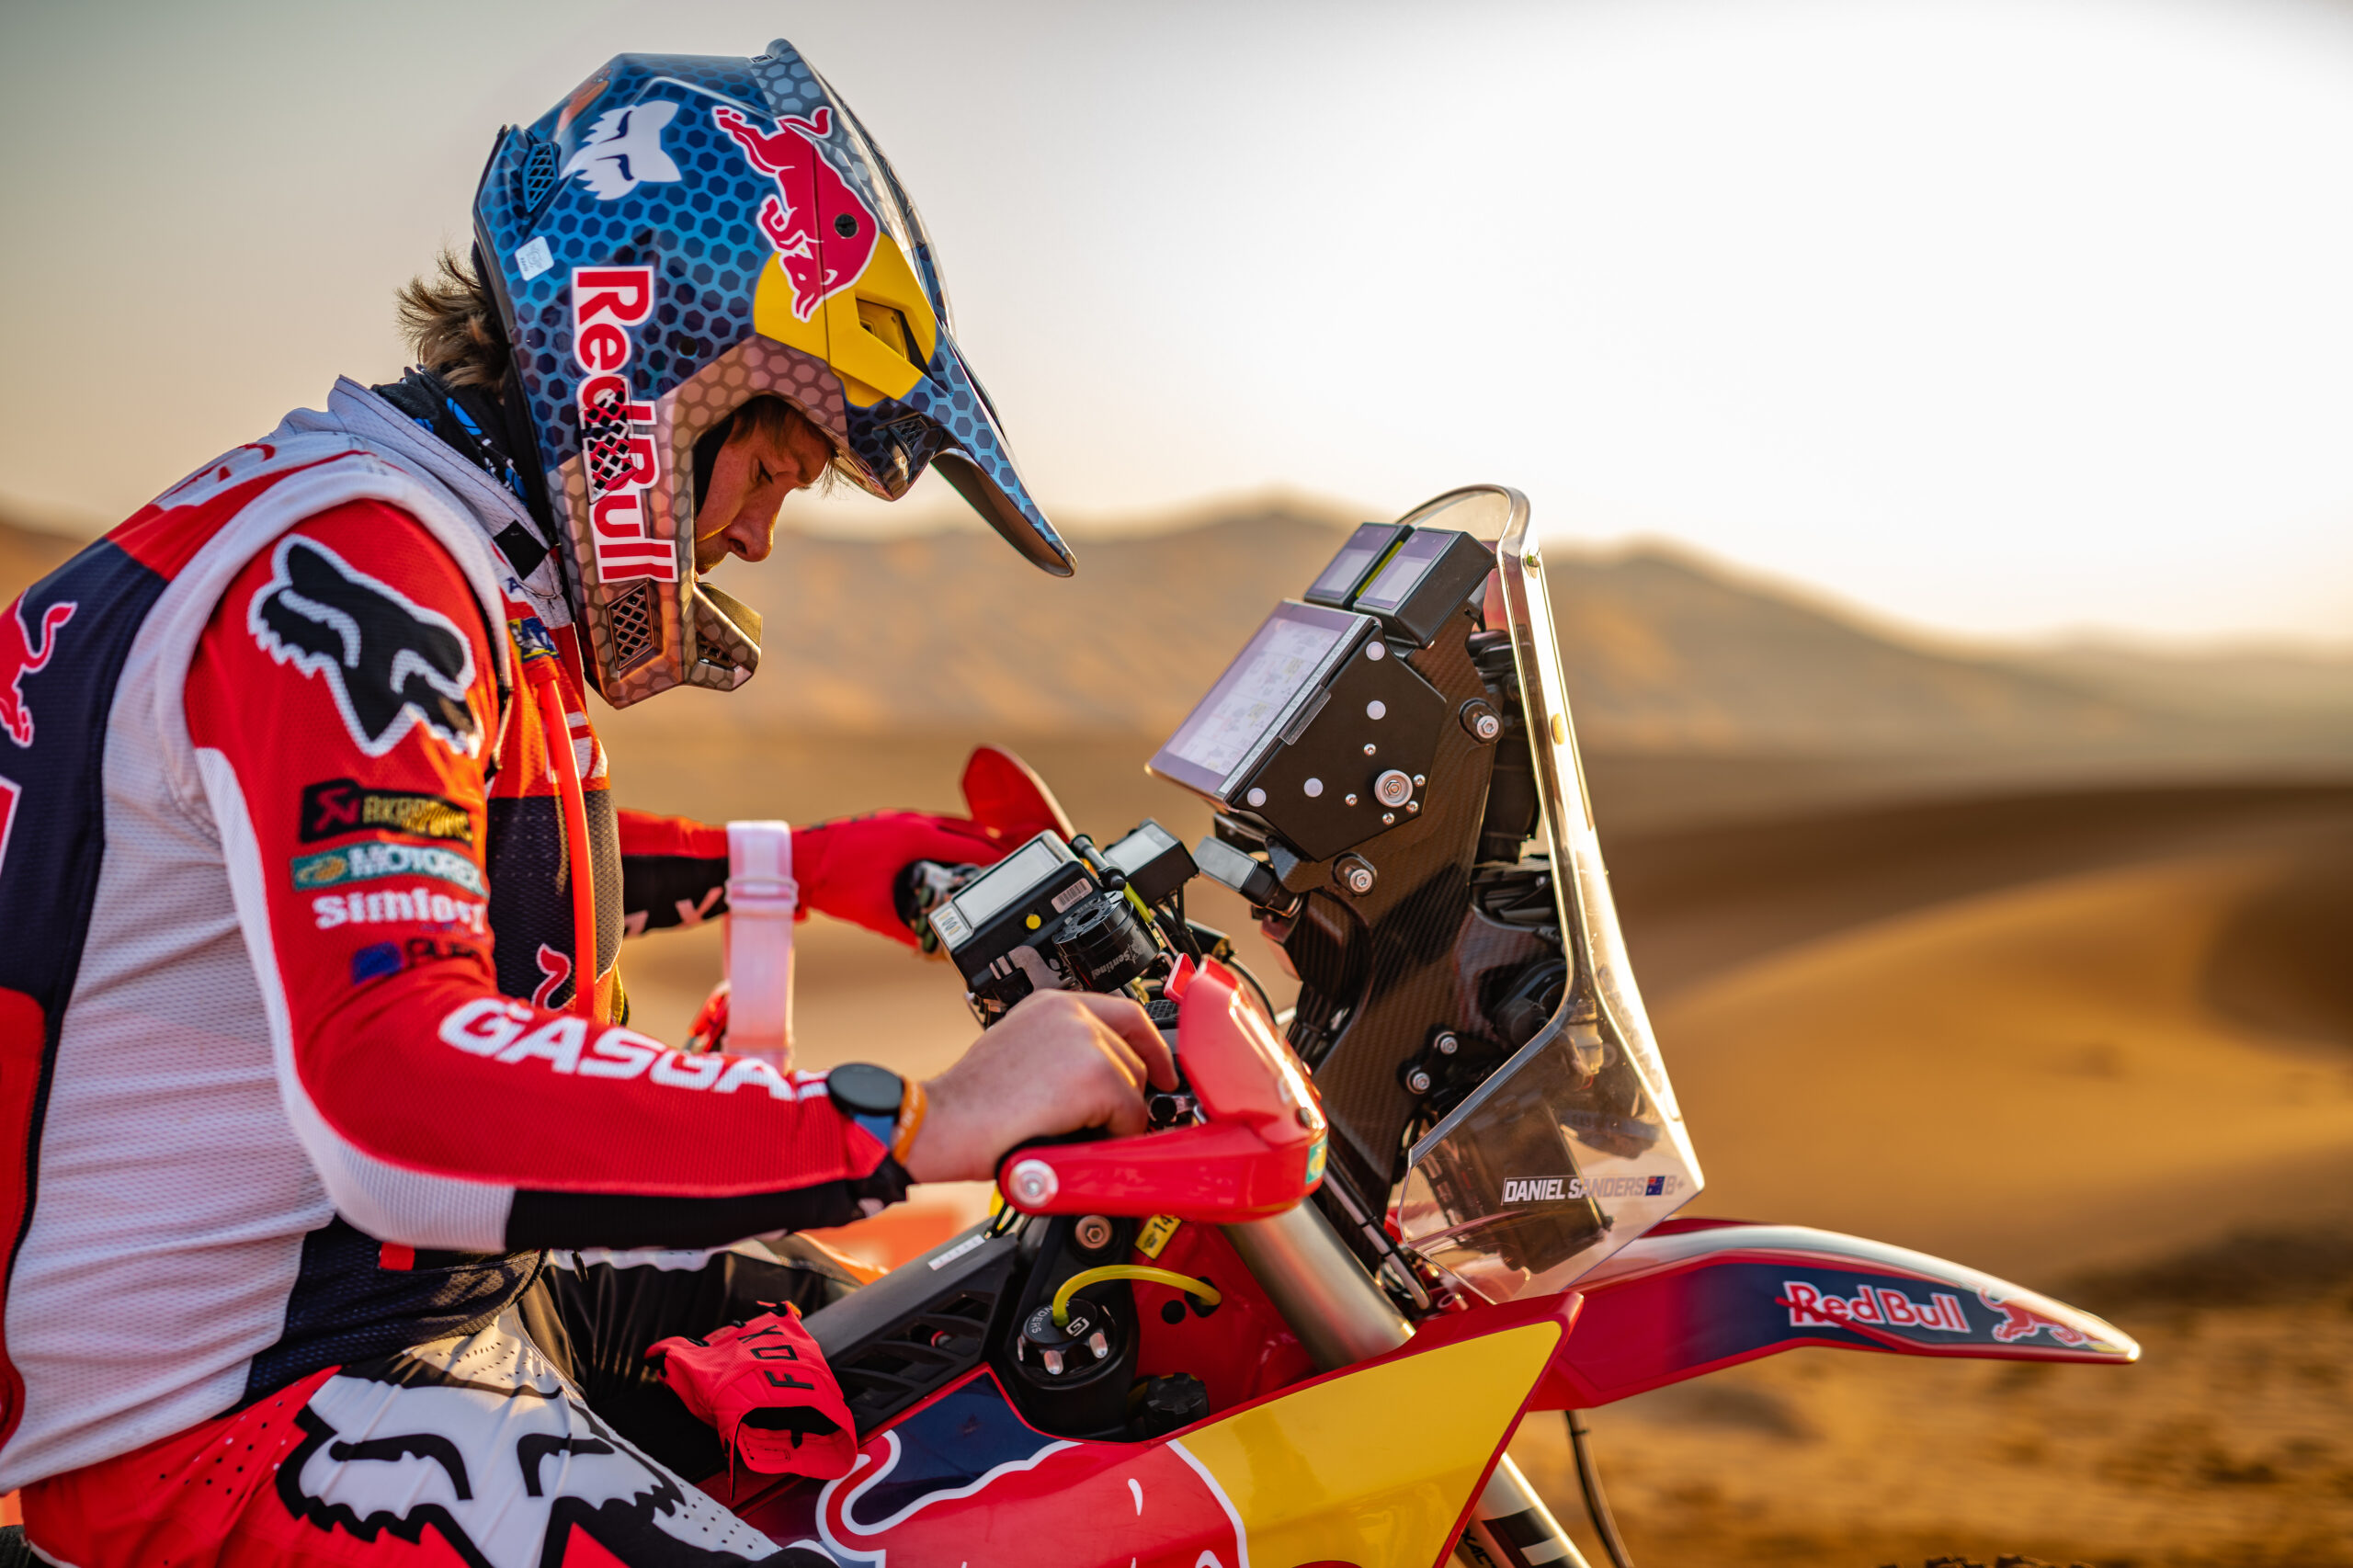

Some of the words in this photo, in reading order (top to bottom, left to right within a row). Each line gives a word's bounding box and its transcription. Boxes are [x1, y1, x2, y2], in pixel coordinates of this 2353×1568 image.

[1503, 1179, 1565, 1203] DANIEL
[1568, 1175, 1646, 1199] SANDERS
[1783, 1280, 1886, 1328] Red
[1875, 1288, 1972, 1333] Bull
[737, 1324, 815, 1391] FOX
